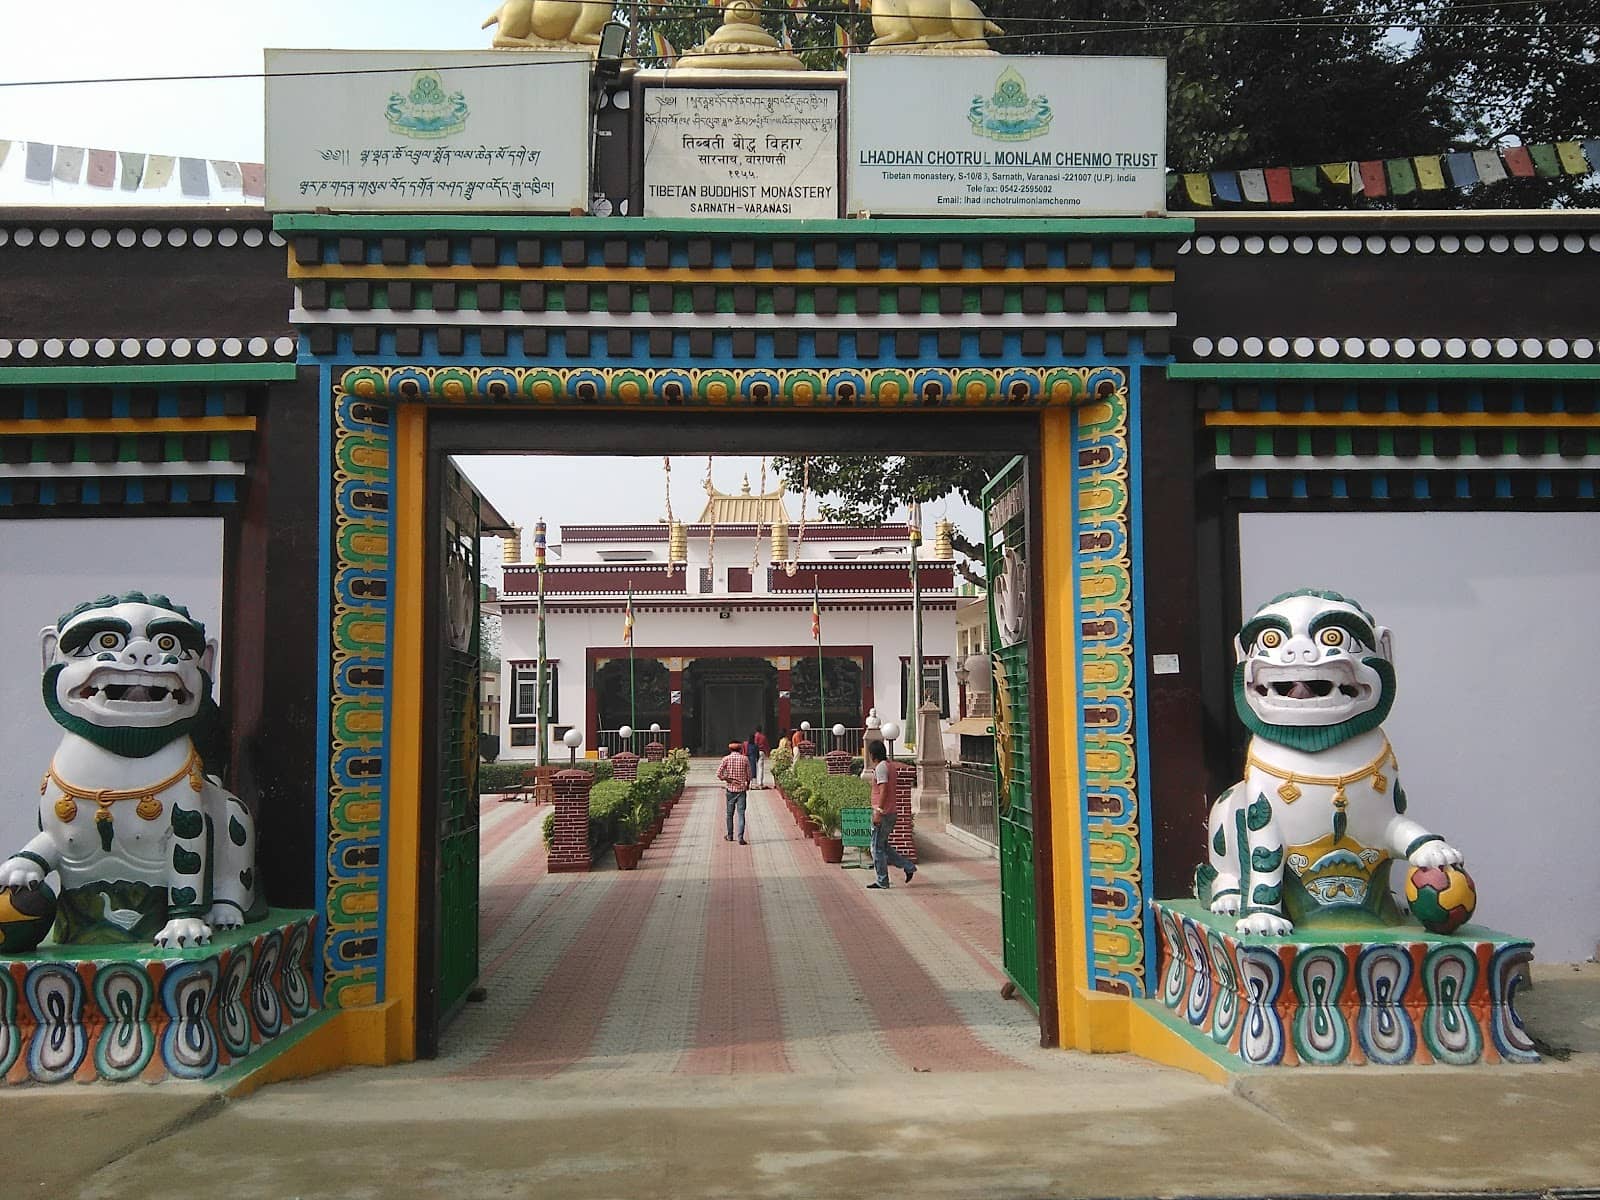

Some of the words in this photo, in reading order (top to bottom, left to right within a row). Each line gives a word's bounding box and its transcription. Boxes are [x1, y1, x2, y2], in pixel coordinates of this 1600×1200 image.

[682, 134, 725, 150] तिब्बती
[766, 134, 803, 150] विहार
[745, 153, 786, 166] वाराणसी
[860, 150, 923, 164] LHADHAN
[927, 150, 991, 165] CHOTRUL
[995, 151, 1052, 166] MONLAM
[1055, 152, 1112, 167] CHENMO
[1115, 153, 1158, 167] TRUST
[882, 171, 911, 180] Tibetan
[913, 172, 956, 182] monastery,
[992, 172, 1025, 182] Sarnath,
[1026, 173, 1060, 182] Varanasi
[1117, 174, 1136, 183] India
[649, 185, 697, 198] TIBETAN
[701, 185, 757, 199] BUDDHIST
[761, 186, 832, 199] MONASTERY
